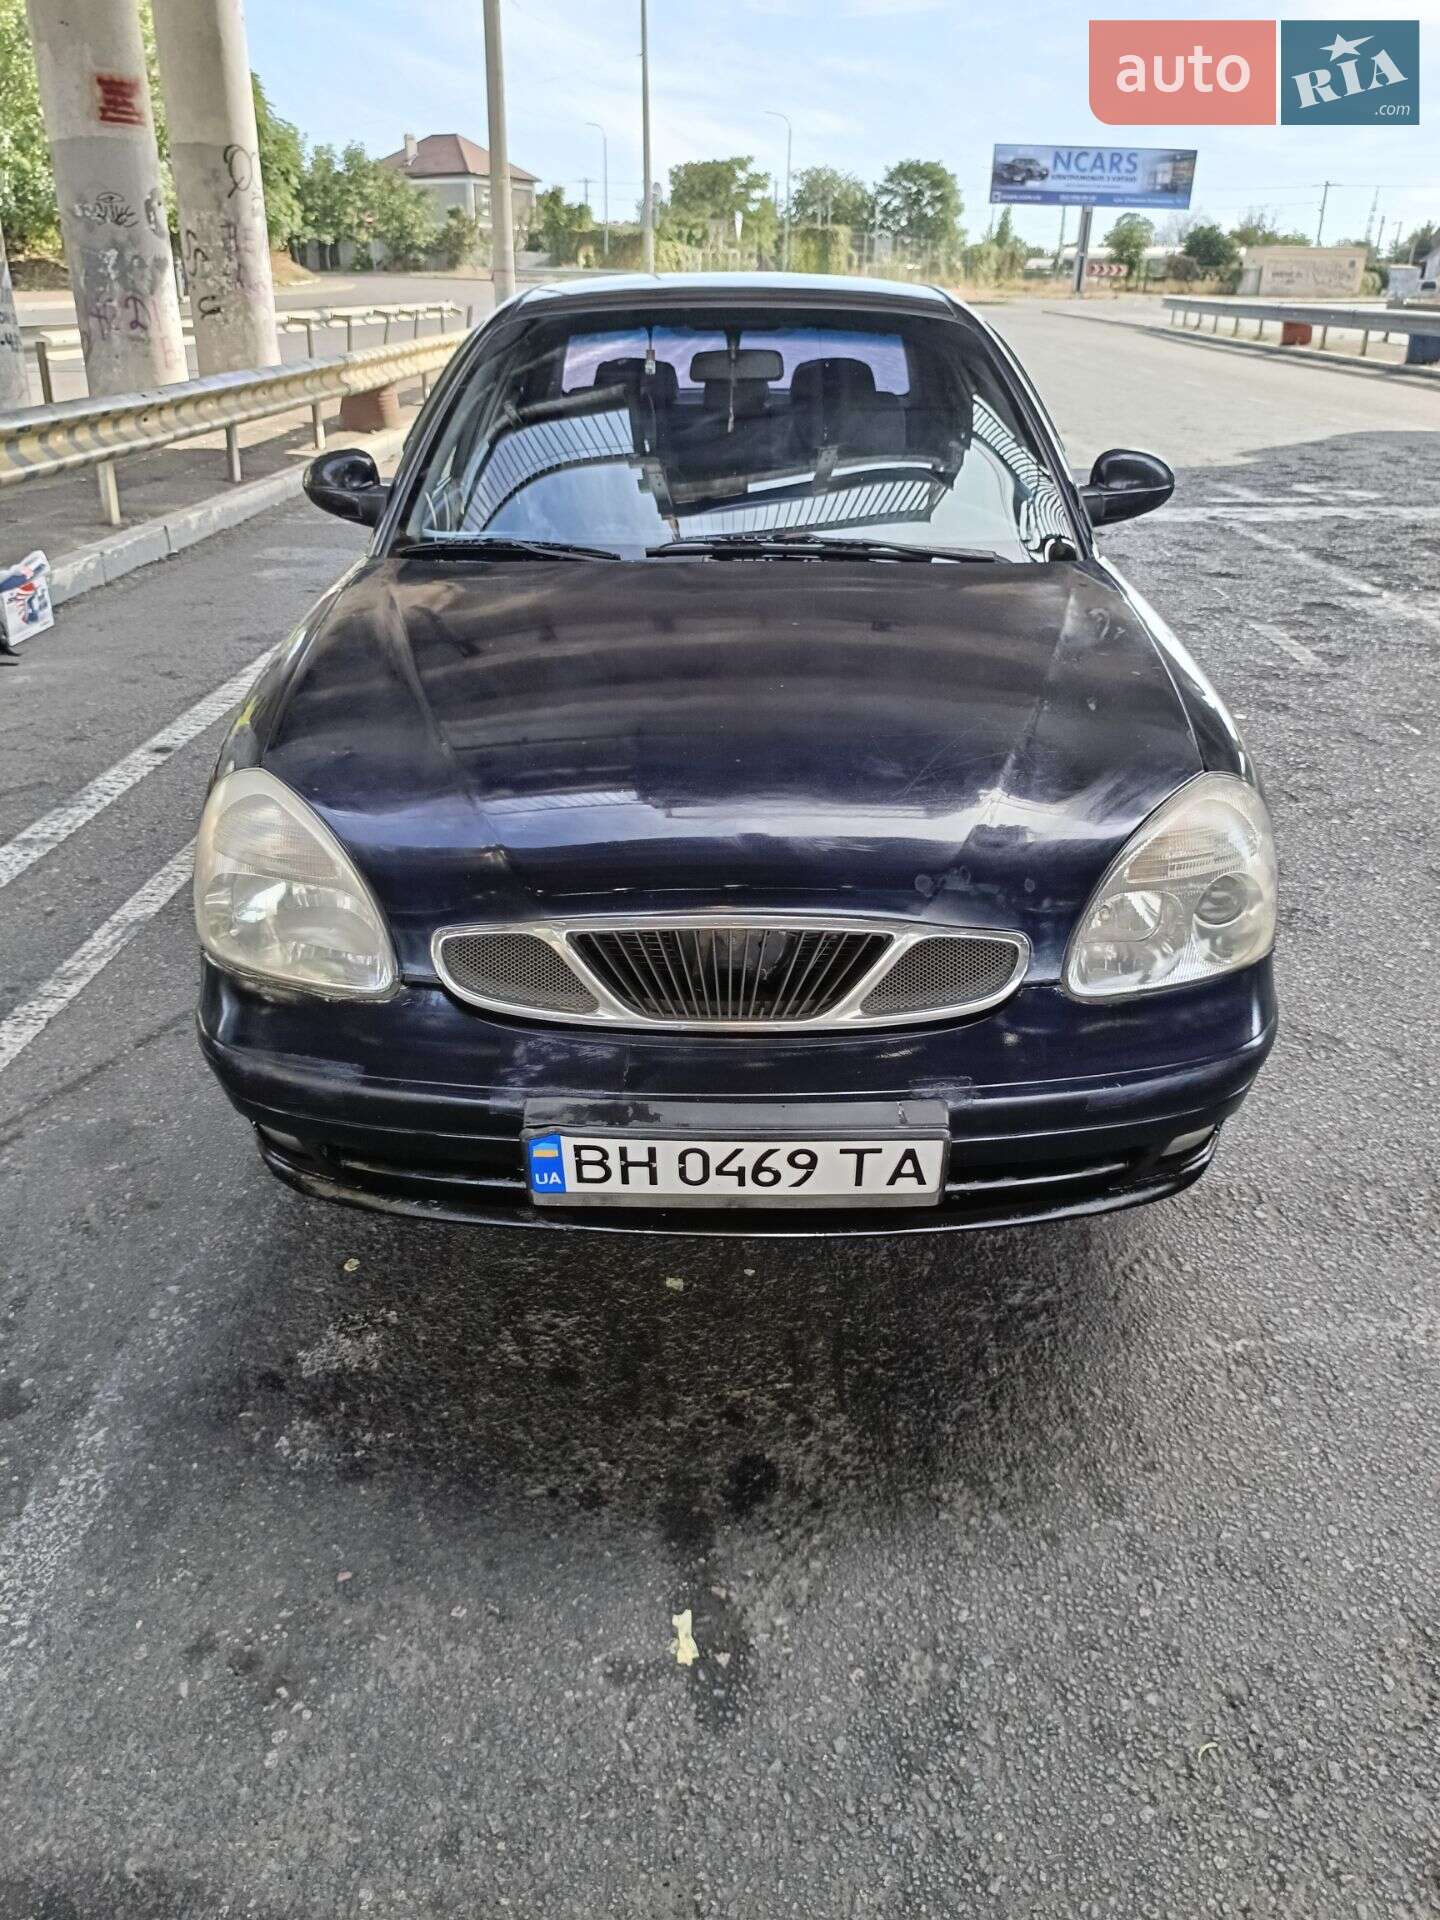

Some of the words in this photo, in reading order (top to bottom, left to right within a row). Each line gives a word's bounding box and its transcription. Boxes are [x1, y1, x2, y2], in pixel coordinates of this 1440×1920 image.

[1052, 150, 1139, 174] NCARS
[573, 1144, 658, 1186] BH
[678, 1147, 819, 1188] 0469
[839, 1148, 927, 1187] TA
[535, 1173, 562, 1186] UA
